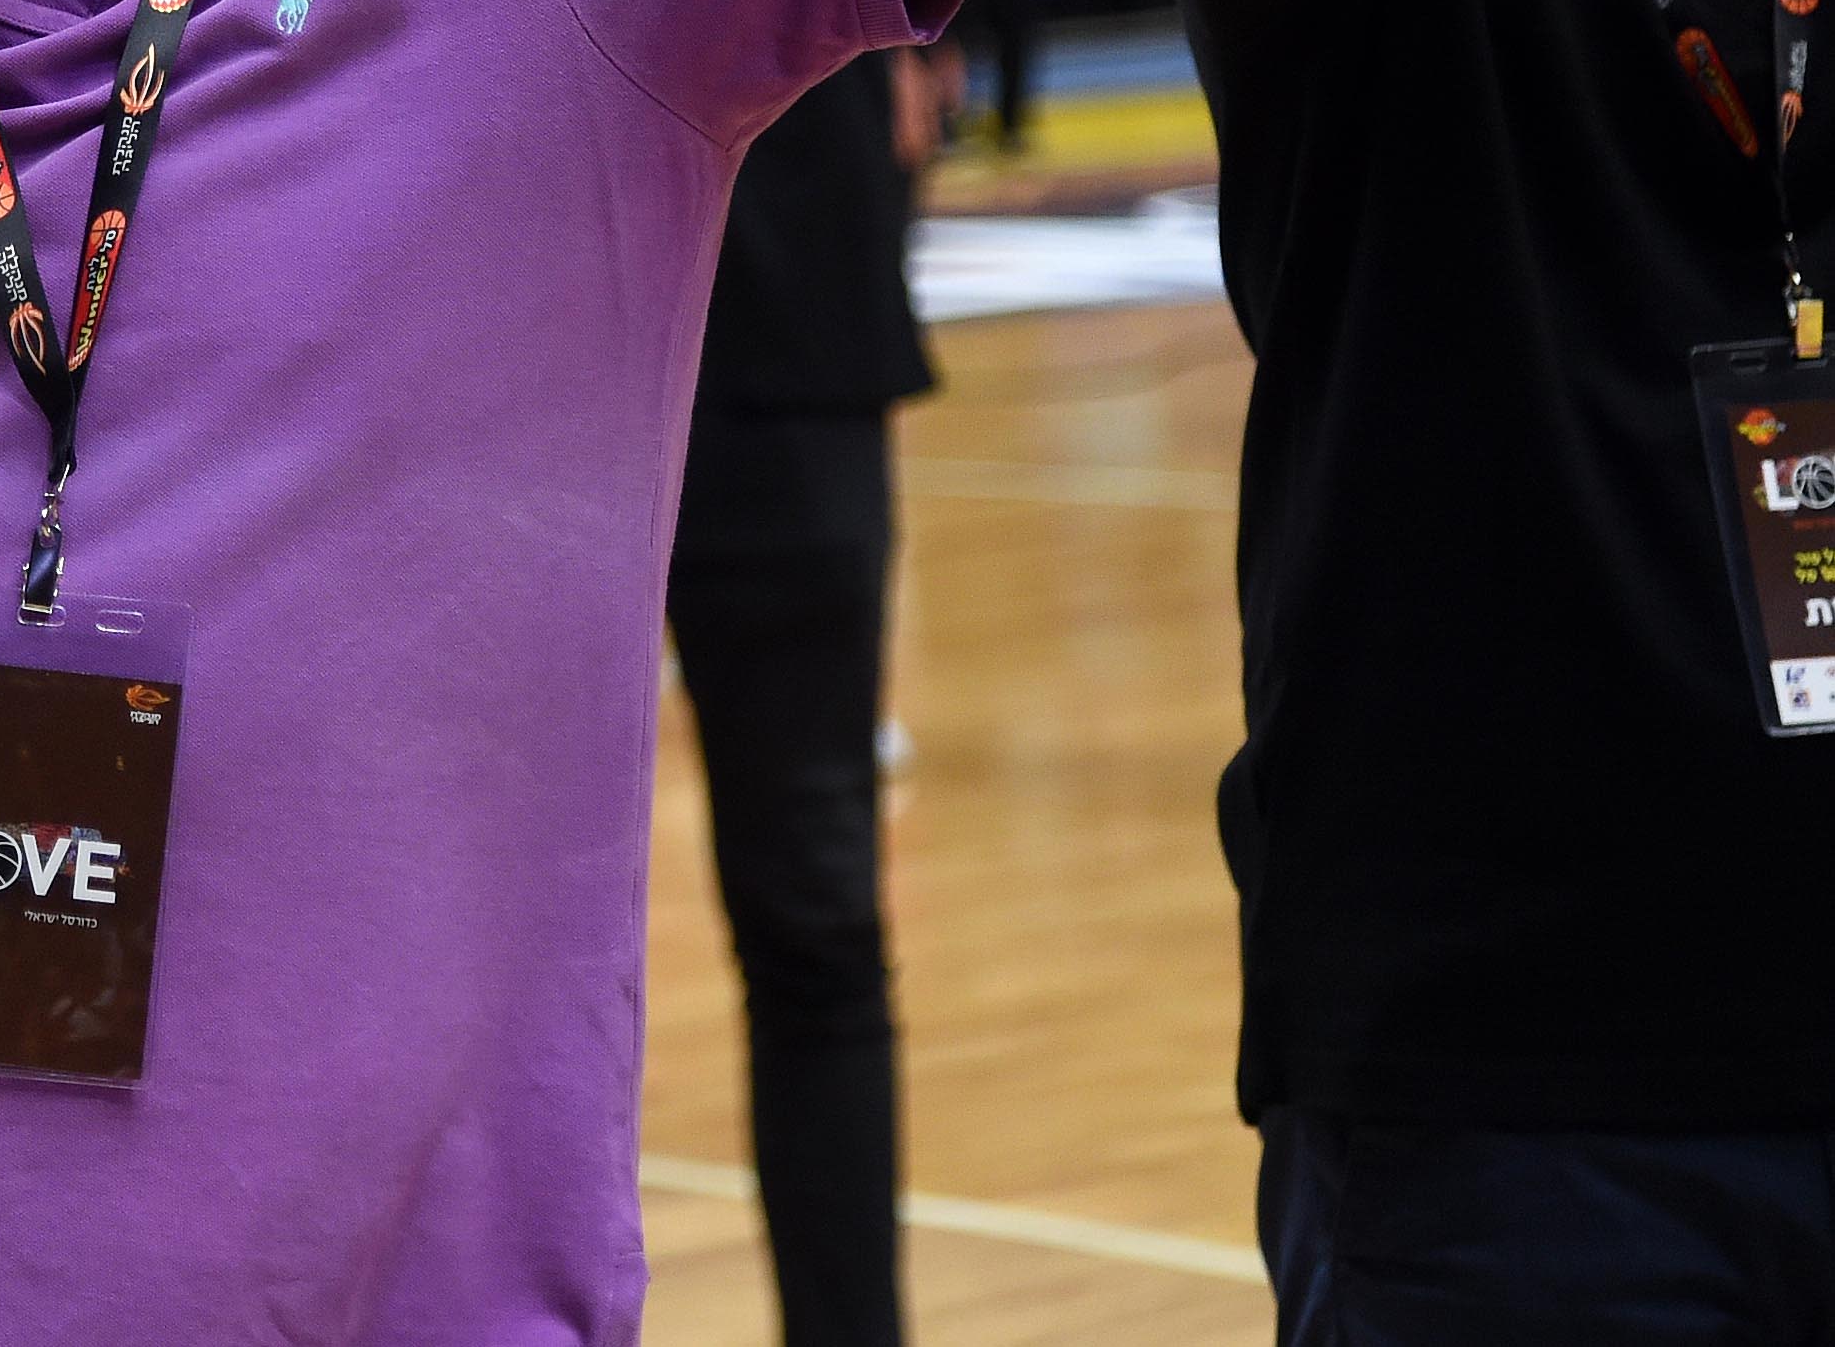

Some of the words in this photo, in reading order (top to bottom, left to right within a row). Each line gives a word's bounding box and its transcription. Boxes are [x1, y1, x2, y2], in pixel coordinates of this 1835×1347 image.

[112, 116, 133, 176] מנהלת
[121, 120, 141, 172] הליגה
[4, 243, 28, 302] מנהלת
[75, 254, 109, 355] Winner
[99, 229, 117, 253] סל
[24, 909, 60, 924] ישראלי
[61, 913, 98, 929] כדורסל
